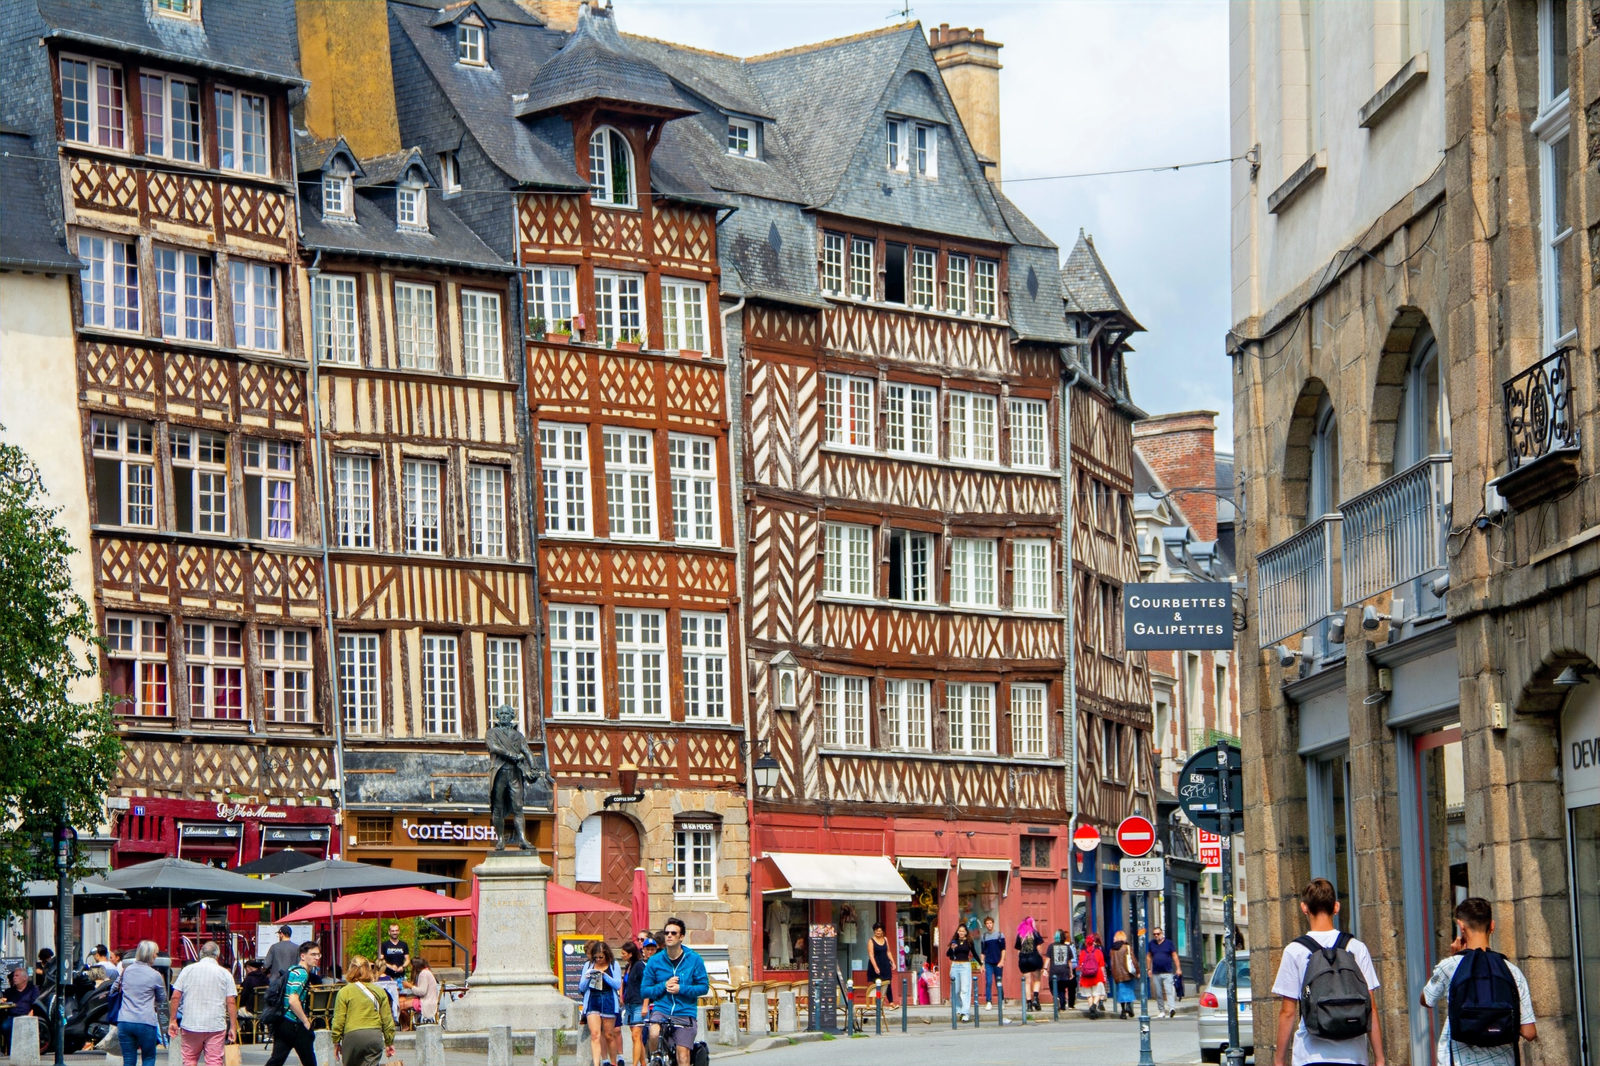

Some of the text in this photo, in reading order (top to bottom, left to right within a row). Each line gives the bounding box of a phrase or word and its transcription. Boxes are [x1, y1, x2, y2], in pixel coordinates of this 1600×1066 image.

[1129, 596, 1226, 608] COURBETTES
[1174, 612, 1182, 621] &
[1133, 622, 1223, 635] GALIPETTES
[1572, 737, 1600, 770] DEV
[184, 827, 219, 835] Restaurant
